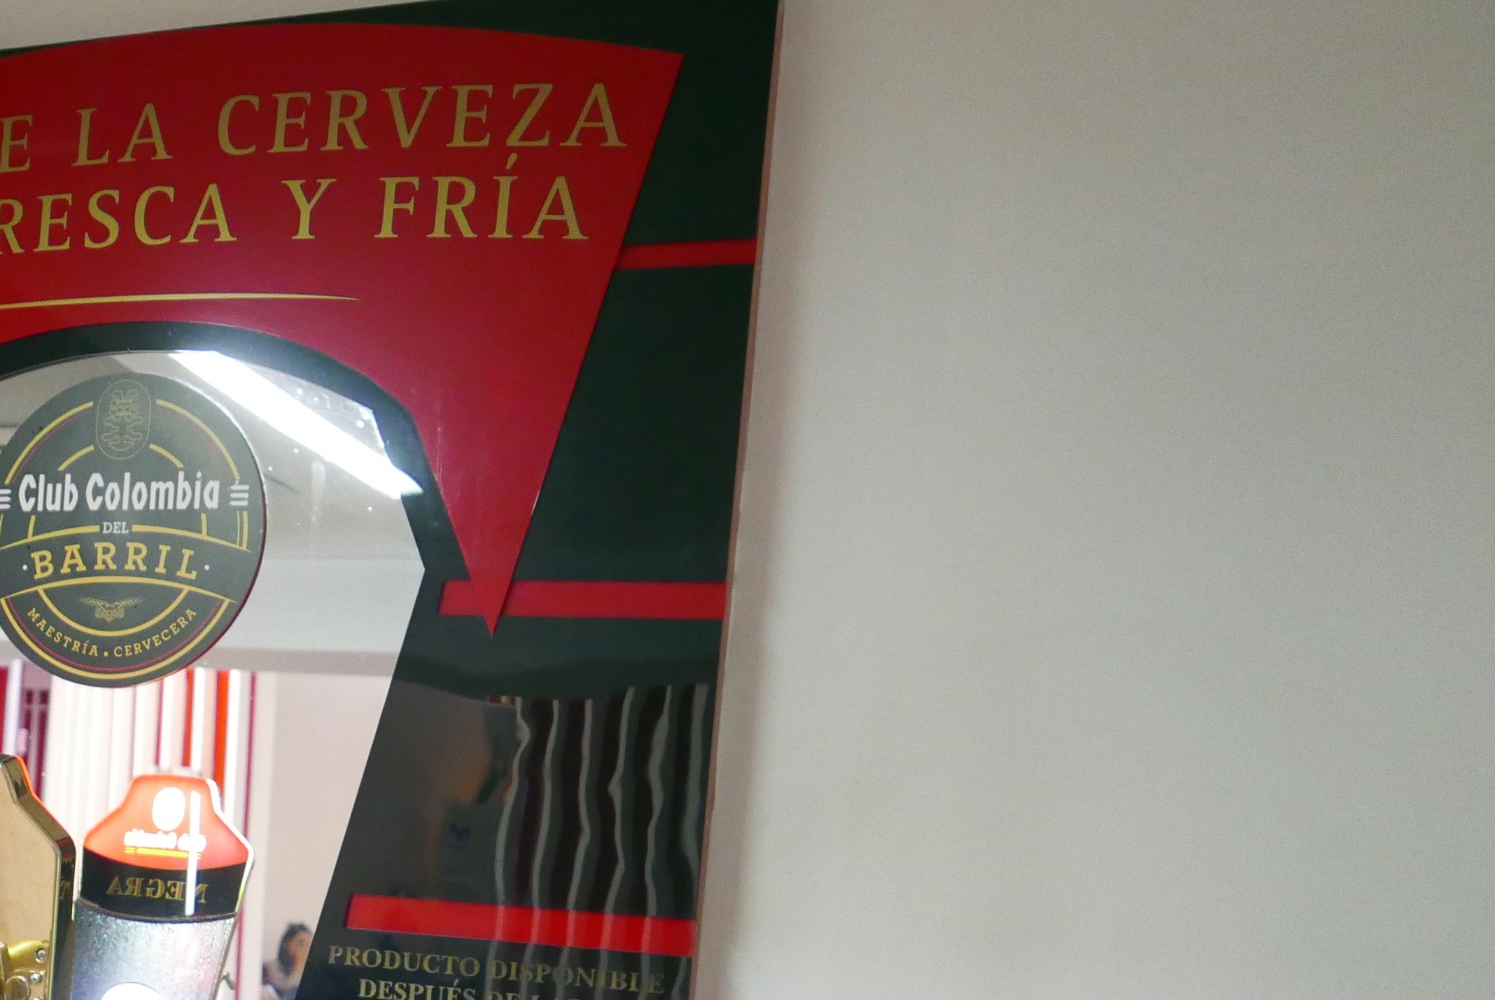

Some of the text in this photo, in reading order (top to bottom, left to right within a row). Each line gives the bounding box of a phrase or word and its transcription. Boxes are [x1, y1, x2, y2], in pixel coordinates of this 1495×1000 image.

[72, 101, 172, 167] LA
[216, 81, 629, 156] CERVEZA
[281, 178, 338, 241] Y
[374, 153, 590, 242] FRÍA
[18, 470, 220, 512] Club Colombia
[102, 522, 129, 534] DEL
[31, 541, 197, 580] BARRIL
[27, 607, 197, 658] MAESTRÍA CERVECERA
[328, 945, 665, 995] PRODUCTO DISPONIBLE
